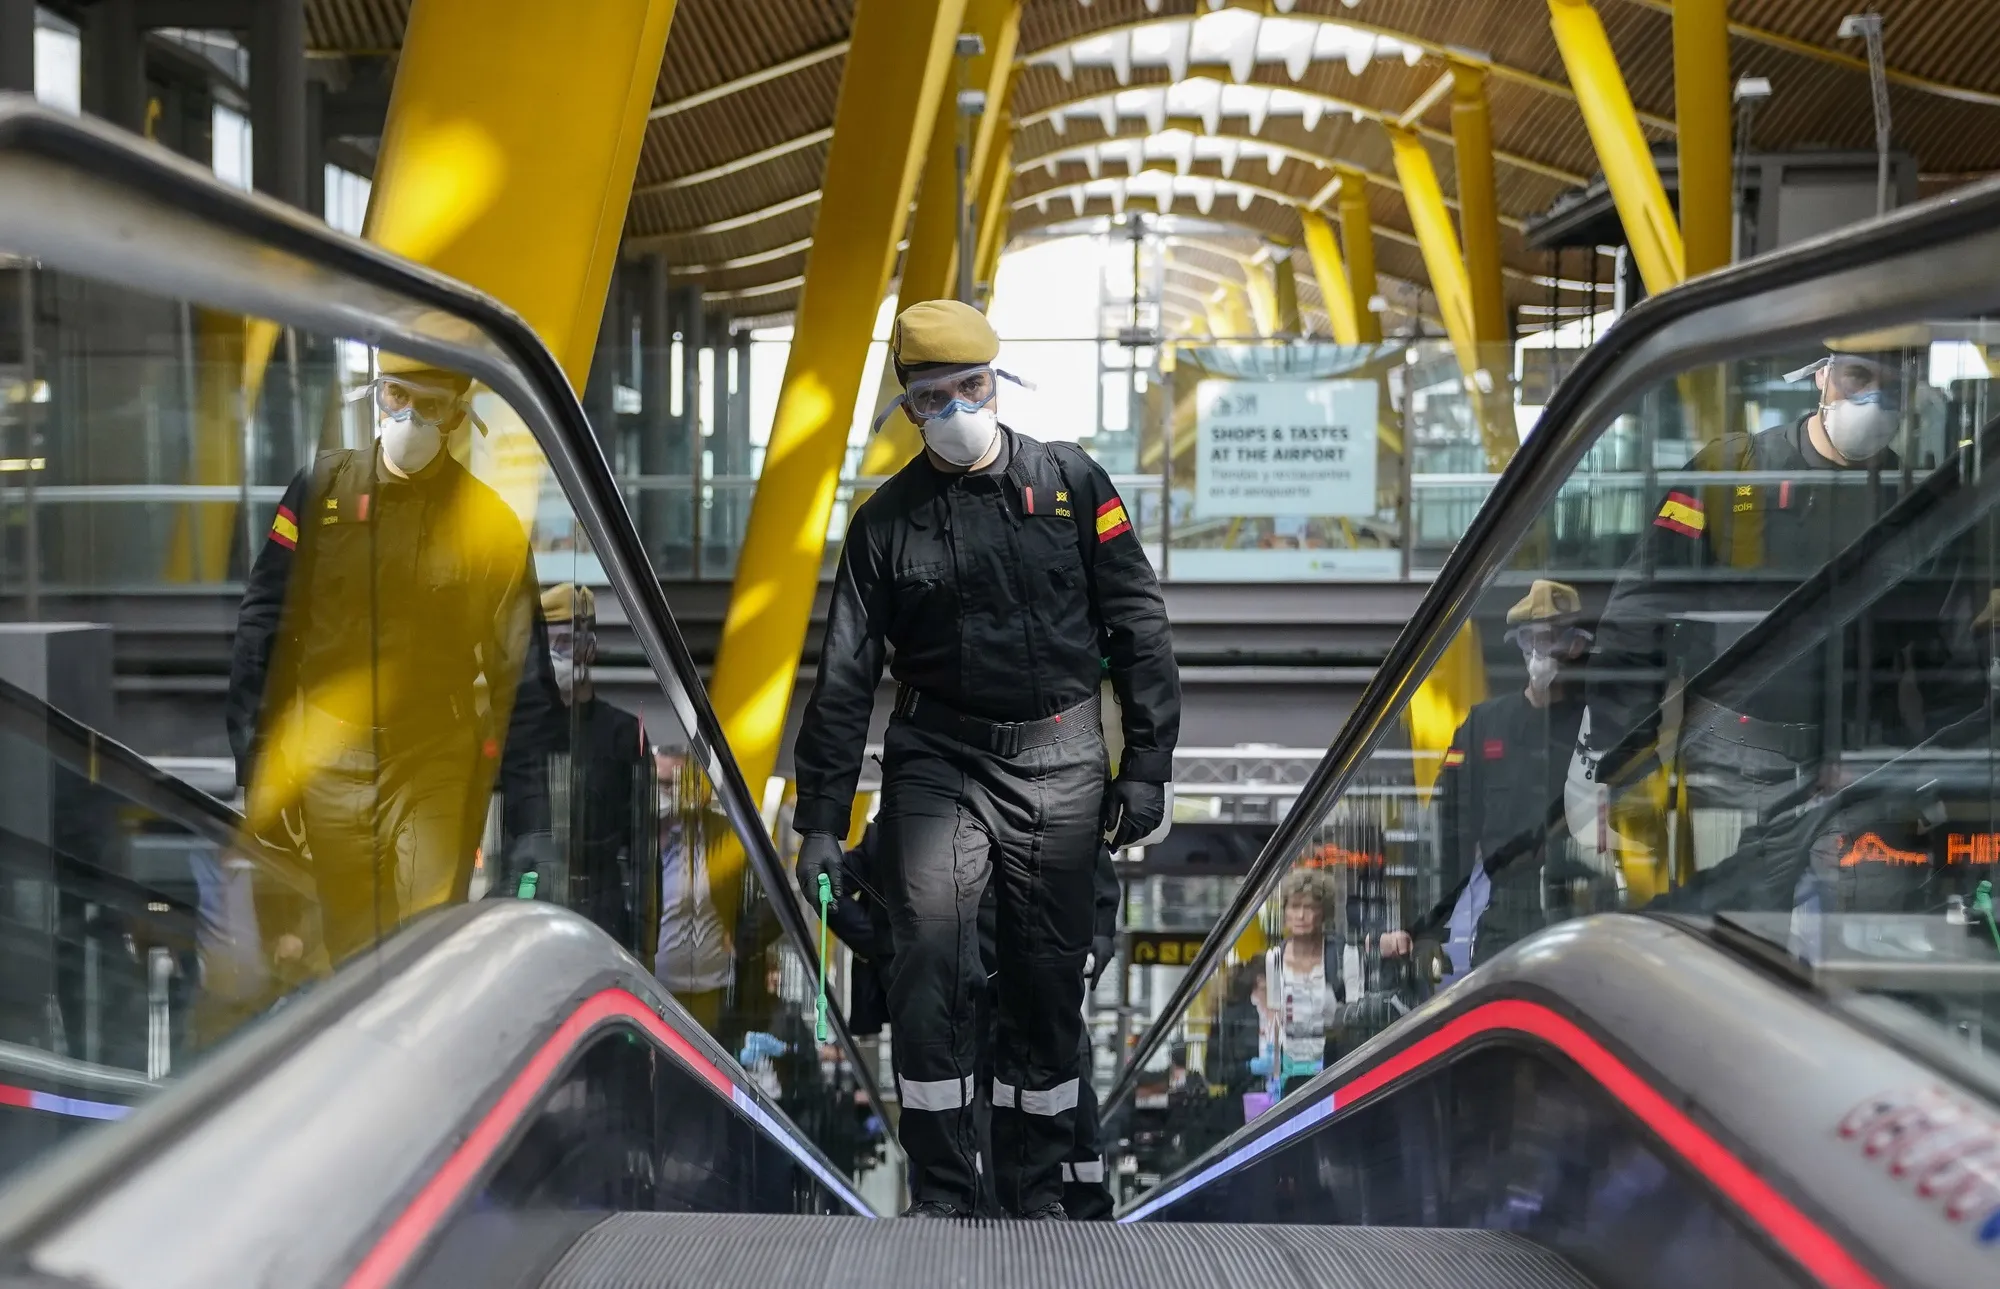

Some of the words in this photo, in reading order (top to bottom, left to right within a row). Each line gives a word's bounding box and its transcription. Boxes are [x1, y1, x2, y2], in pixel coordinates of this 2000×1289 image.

[1211, 428, 1267, 441] SHOPS
[1272, 427, 1283, 441] &
[1289, 427, 1349, 441] TASTES
[1210, 448, 1231, 462] AT
[1236, 448, 1267, 461] THE
[1273, 448, 1345, 462] AIRPORT
